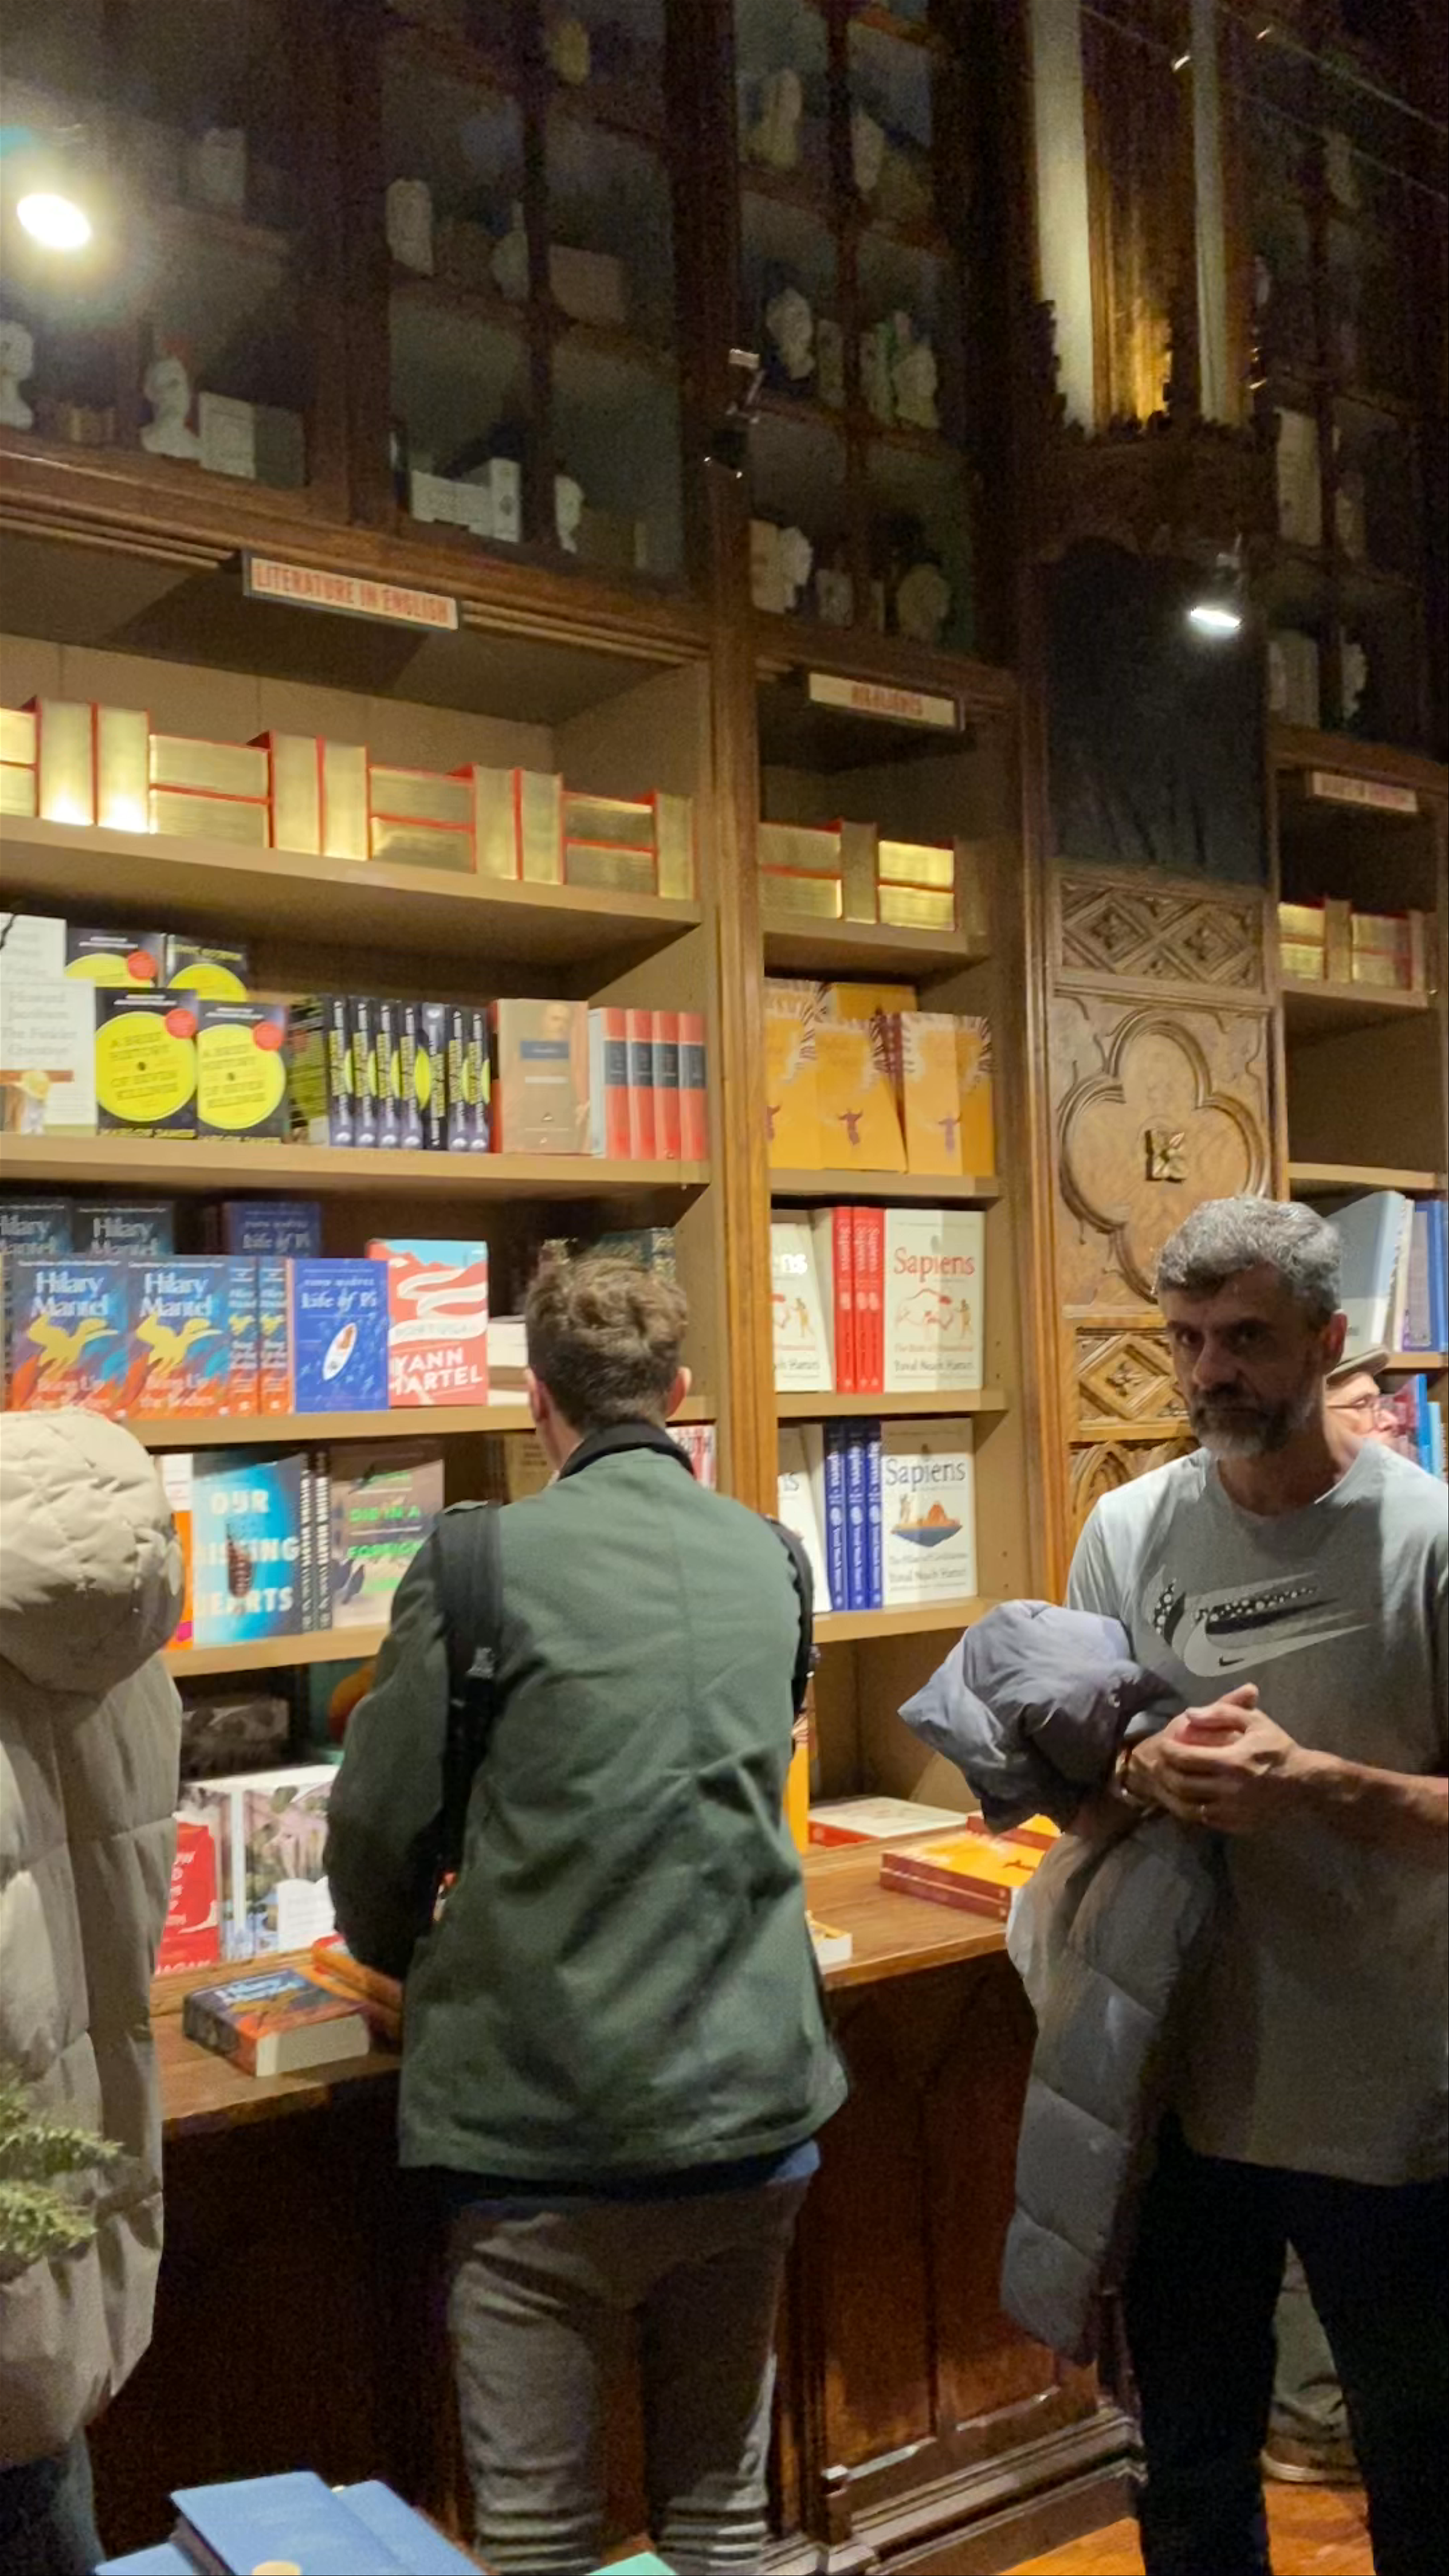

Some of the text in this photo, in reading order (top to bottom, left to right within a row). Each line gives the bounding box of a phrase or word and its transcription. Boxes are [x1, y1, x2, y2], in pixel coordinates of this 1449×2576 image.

[0, 1215, 51, 1241] ilary
[894, 1246, 975, 1283] Sapiens
[35, 1271, 105, 1299] Hilary
[143, 1272, 209, 1299] Hilary
[31, 1295, 108, 1317] Mantel
[139, 1296, 213, 1317] Mantel
[884, 1458, 966, 1493] Sapiens
[210, 1488, 270, 1515] OUR
